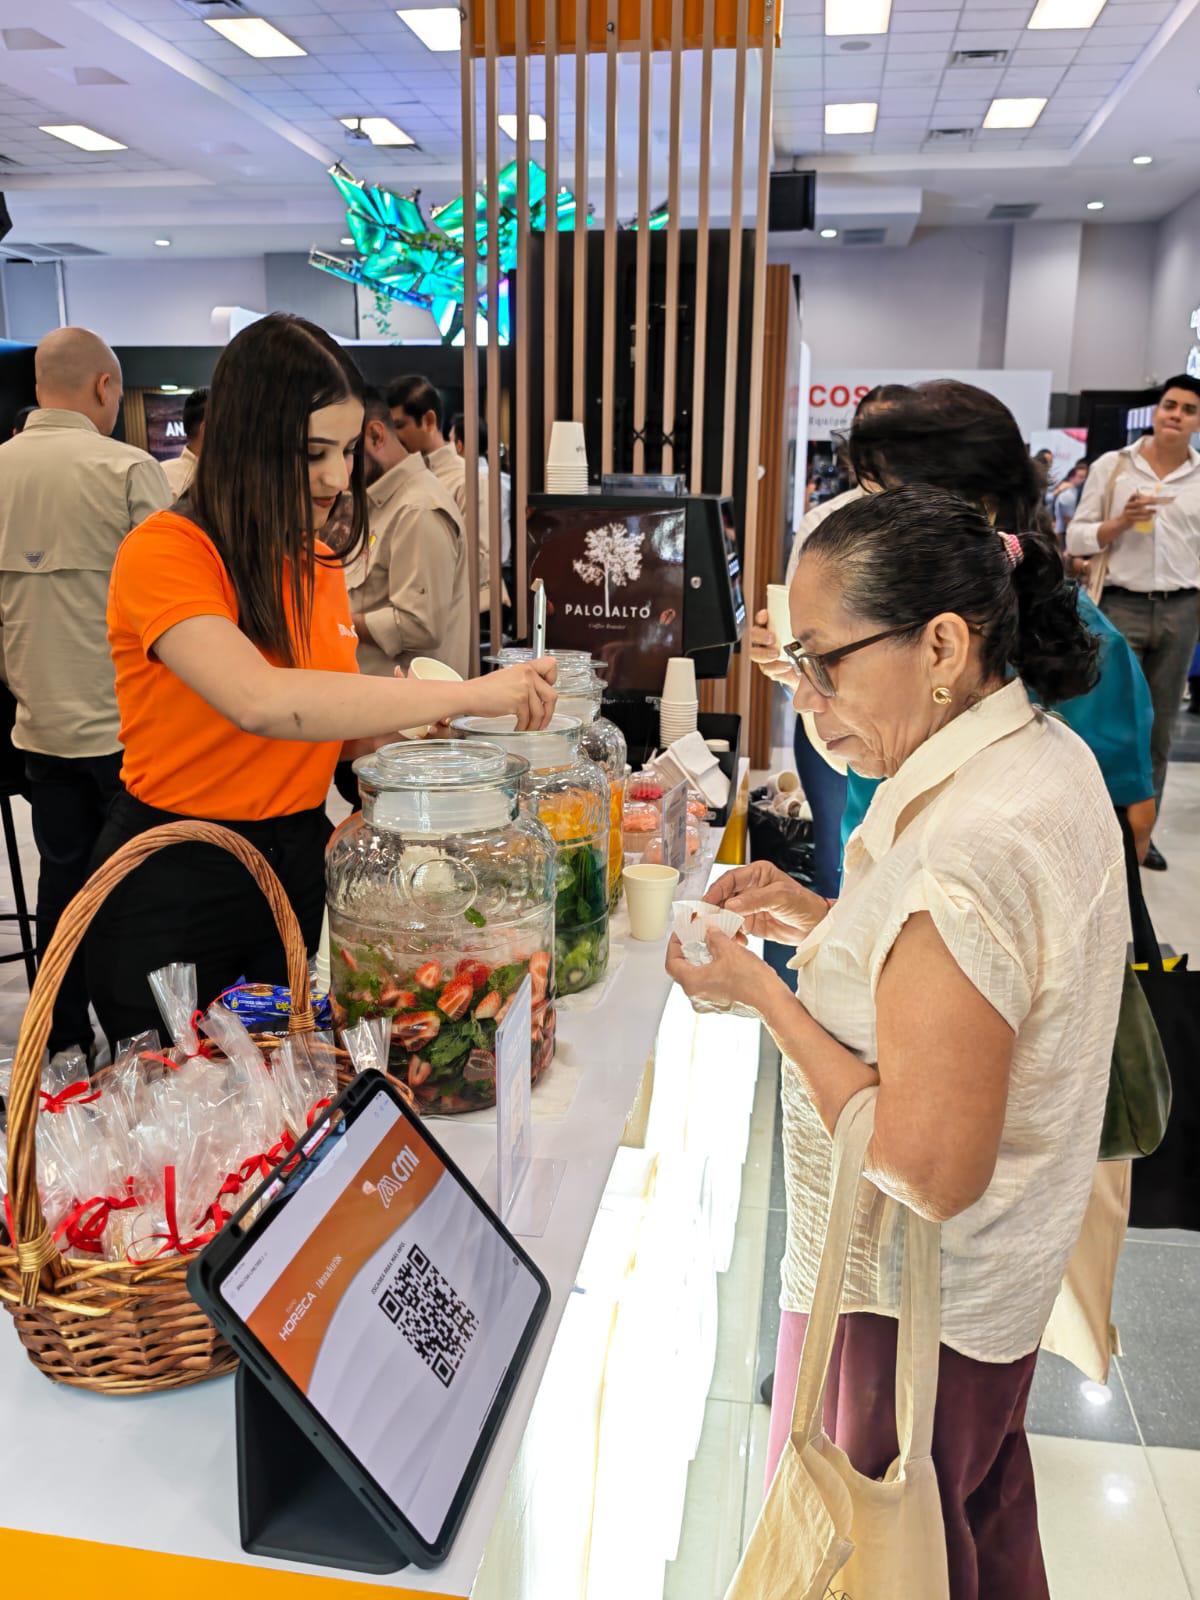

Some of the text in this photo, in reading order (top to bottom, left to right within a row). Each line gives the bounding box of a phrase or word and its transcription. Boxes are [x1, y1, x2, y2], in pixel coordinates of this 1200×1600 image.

[166, 421, 187, 437] AN
[565, 603, 651, 618] PALO ALTO
[391, 1144, 420, 1183] CMI
[278, 1291, 317, 1342] HORECA
